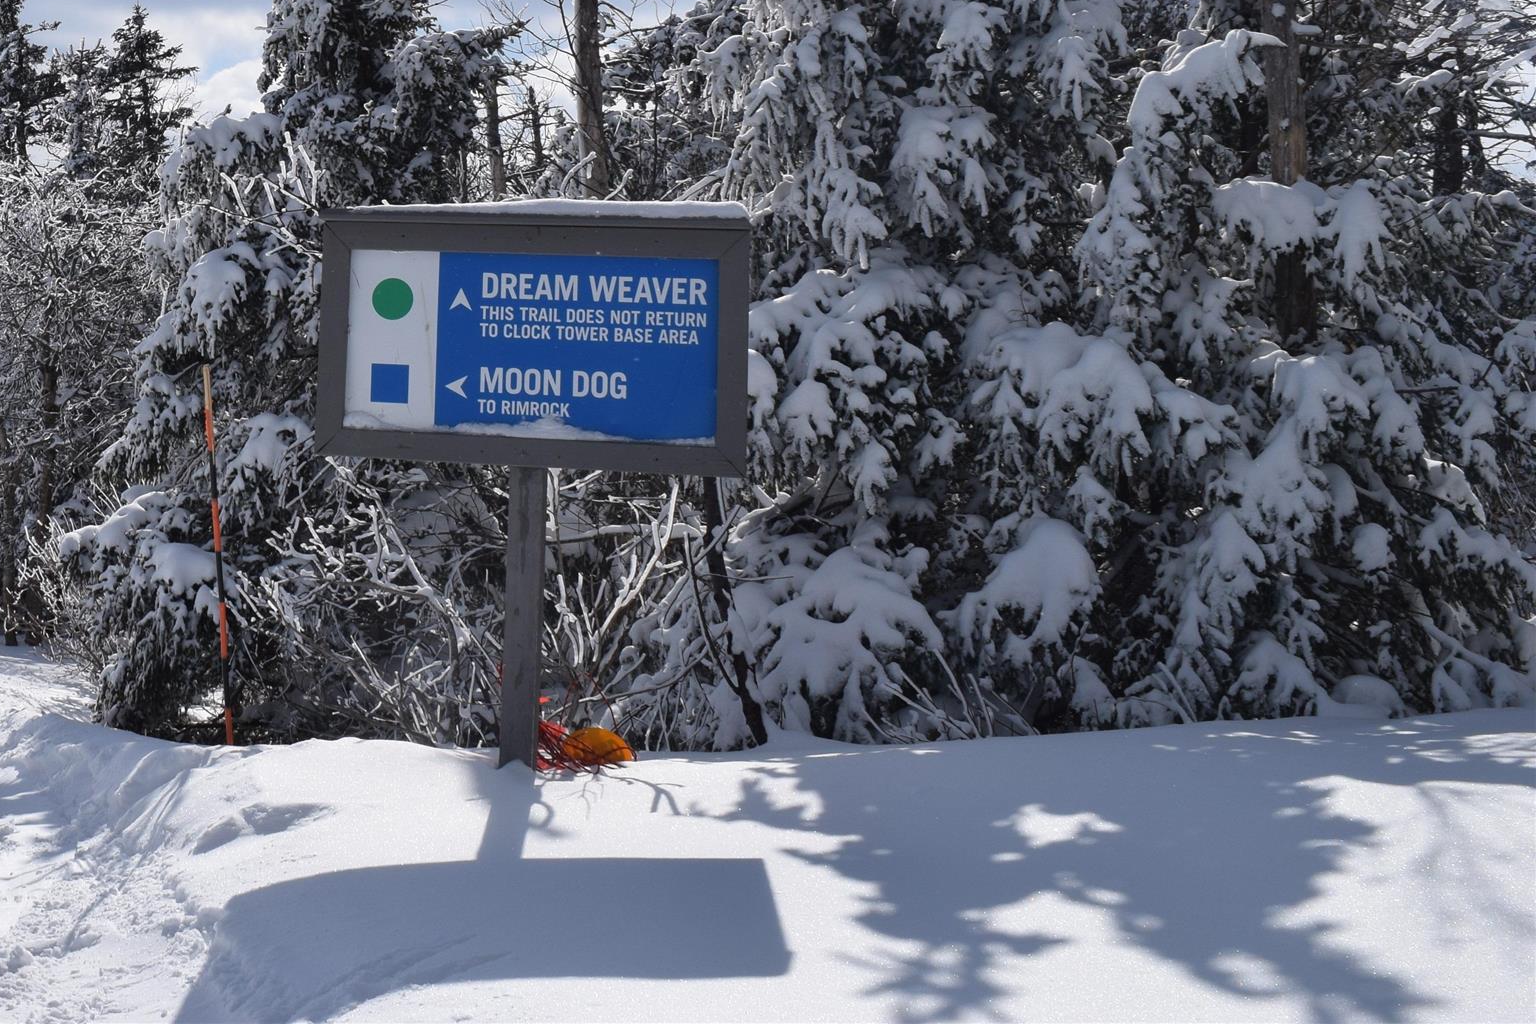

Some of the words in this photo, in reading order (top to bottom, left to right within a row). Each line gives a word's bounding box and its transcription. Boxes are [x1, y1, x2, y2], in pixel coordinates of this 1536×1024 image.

[482, 272, 578, 301] DREAM
[589, 275, 707, 305] WEAVER
[480, 305, 514, 321] THIS
[519, 307, 561, 323] TRAIL
[566, 309, 604, 324] DOES
[610, 310, 641, 325] NOT
[646, 311, 706, 327] RETURN
[479, 323, 498, 338] TO
[503, 324, 550, 339] CLOCK
[556, 326, 609, 342] TOWER
[614, 327, 653, 343] BASE
[658, 329, 699, 345] AREA
[480, 366, 561, 396] MOON
[572, 370, 627, 399] DOG
[478, 399, 496, 414] TO
[501, 400, 569, 417] RIMROCK
